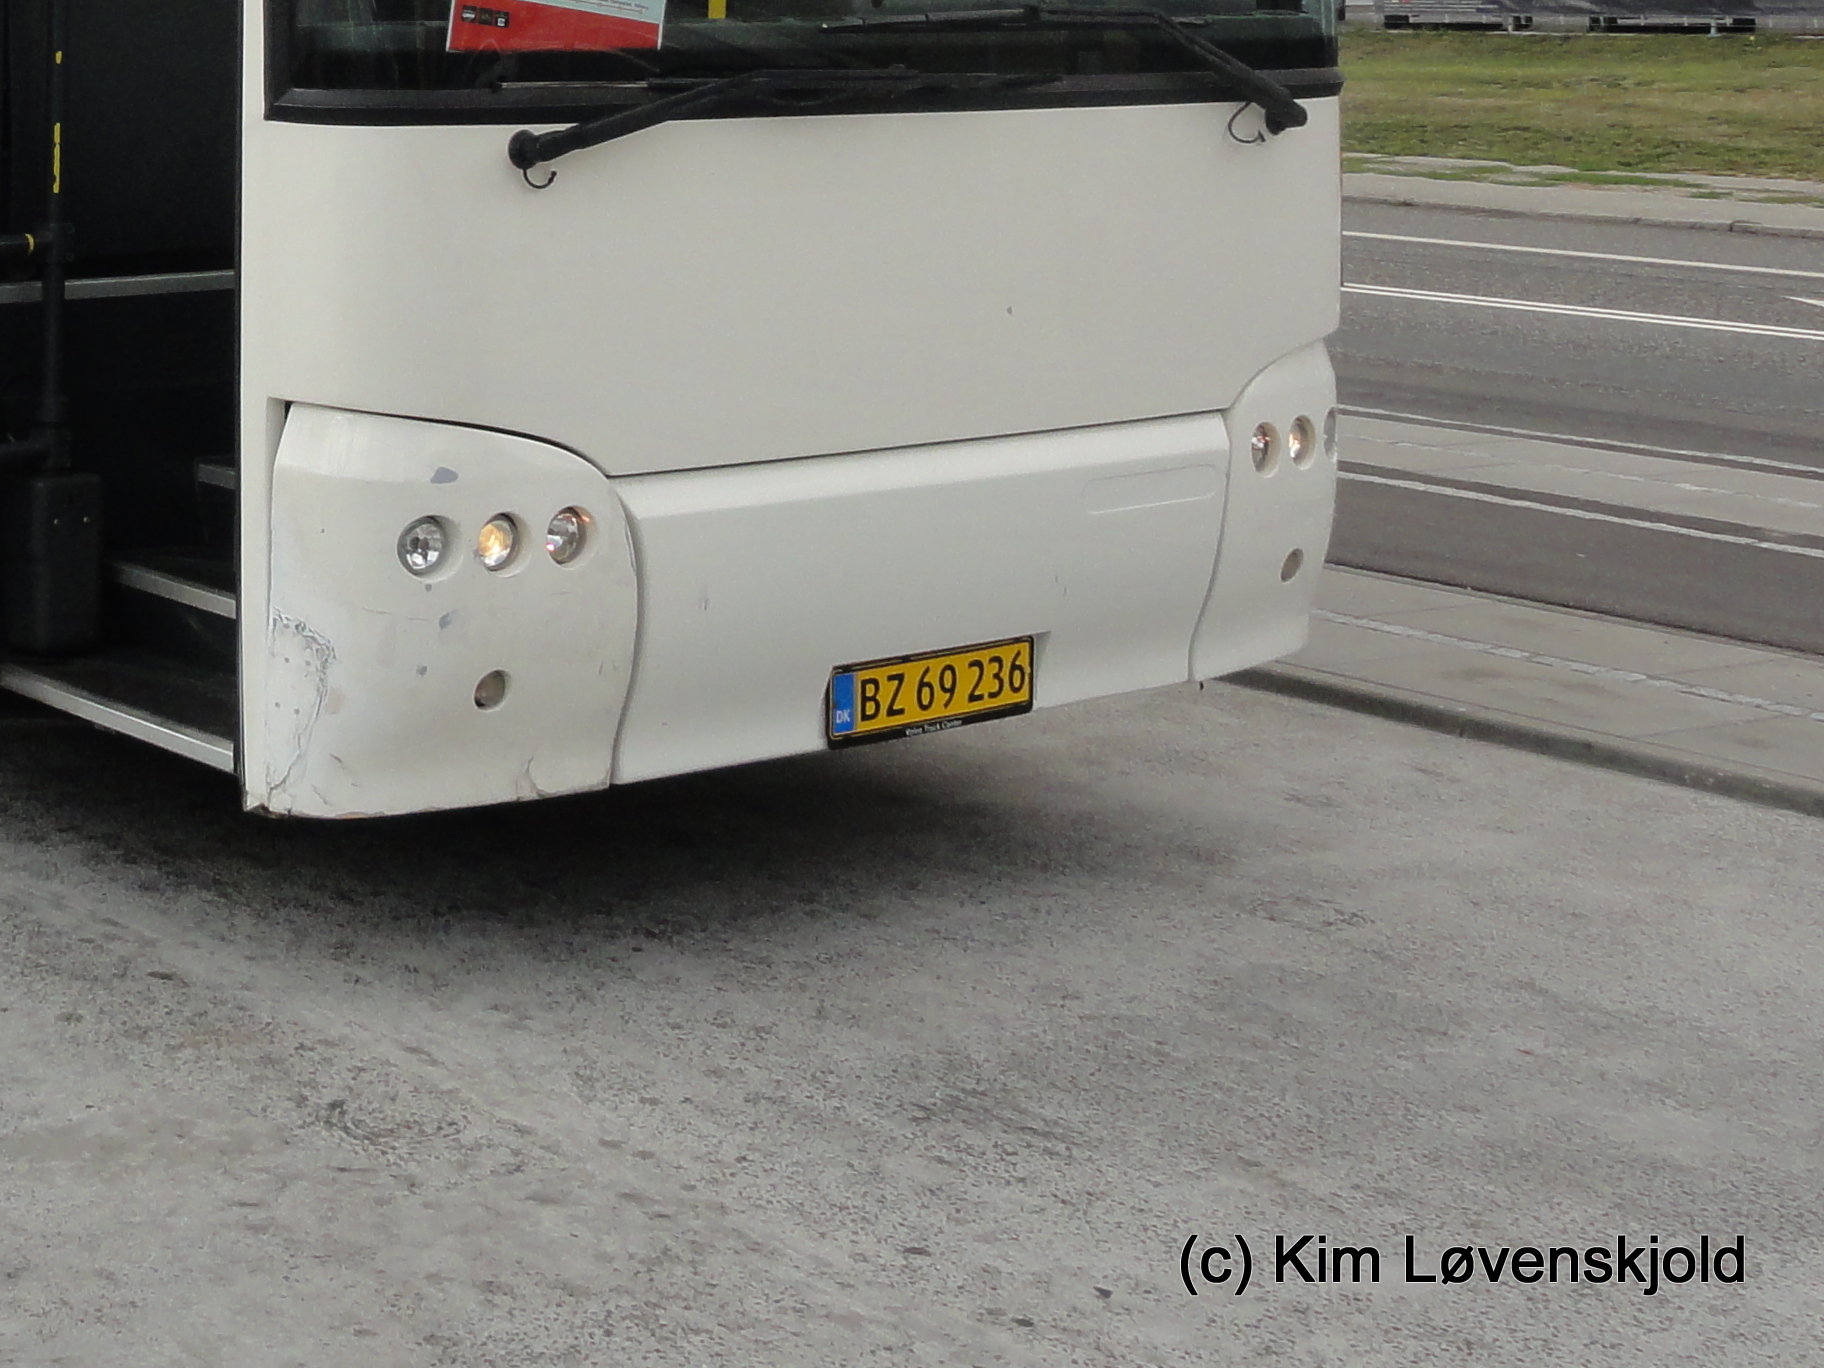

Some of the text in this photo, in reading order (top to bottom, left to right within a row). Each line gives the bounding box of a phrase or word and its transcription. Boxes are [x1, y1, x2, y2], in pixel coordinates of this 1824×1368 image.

[859, 649, 1026, 722] BZ 69 236
[835, 709, 851, 724] DK
